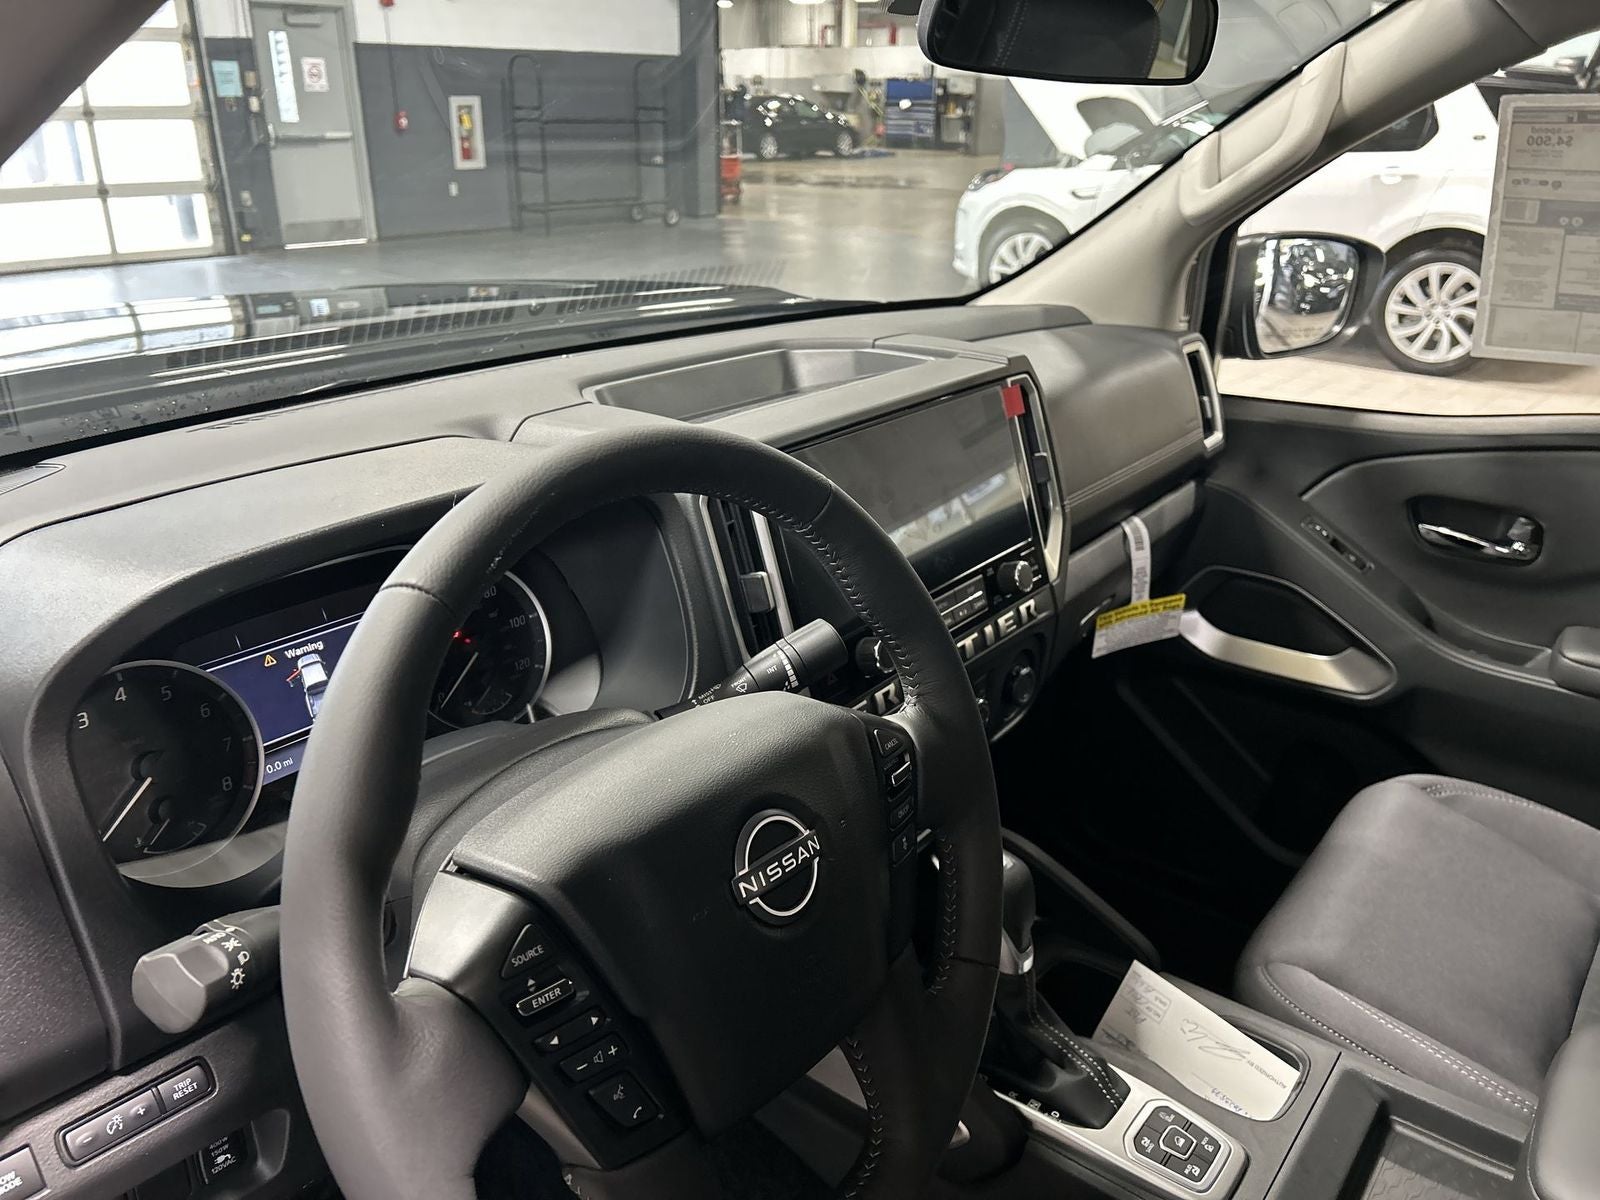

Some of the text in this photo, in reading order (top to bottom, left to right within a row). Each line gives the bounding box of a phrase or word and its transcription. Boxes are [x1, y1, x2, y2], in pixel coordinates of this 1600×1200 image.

[509, 614, 527, 629] 100
[284, 640, 325, 659] Warning
[514, 657, 531, 671] 120
[766, 664, 778, 675] INT
[113, 686, 128, 702] 4
[160, 685, 172, 702] 5
[702, 694, 716, 704] OFF
[199, 701, 212, 718] 6
[75, 711, 89, 729] 3
[222, 736, 233, 753] 7
[265, 757, 294, 774] 0.0 mi
[222, 775, 234, 792] 8
[737, 835, 821, 899] NISSAN
[511, 944, 545, 968] SOURCE
[531, 986, 562, 1009] ENTER
[172, 1081, 198, 1101] RESET
[173, 1077, 192, 1092] TRIP
[210, 1142, 229, 1157] 150W
[211, 1157, 237, 1174] 120VAC
